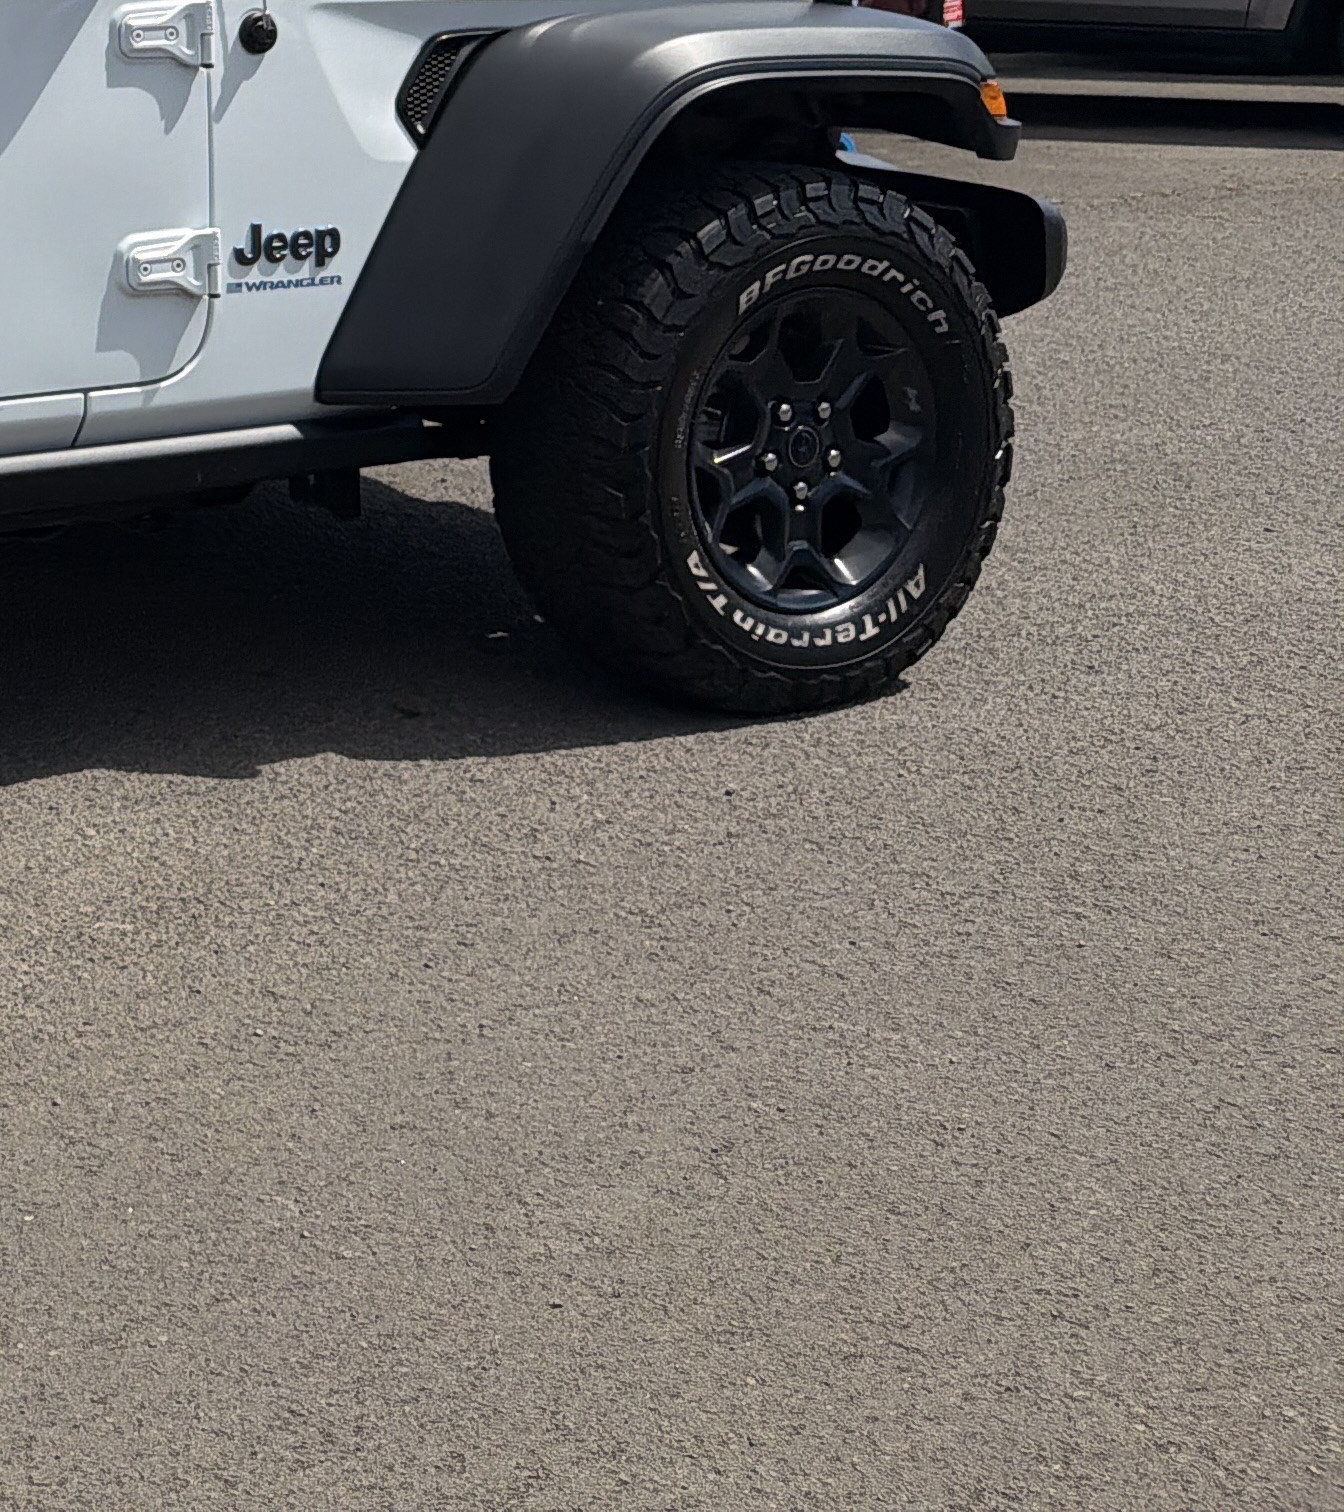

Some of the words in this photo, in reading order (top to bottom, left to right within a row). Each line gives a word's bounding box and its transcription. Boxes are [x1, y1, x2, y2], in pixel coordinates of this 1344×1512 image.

[233, 222, 341, 268] Jeep
[244, 274, 343, 292] WRANGLER
[738, 254, 950, 333] BFGoodrich
[732, 562, 926, 648] All-Terrain
